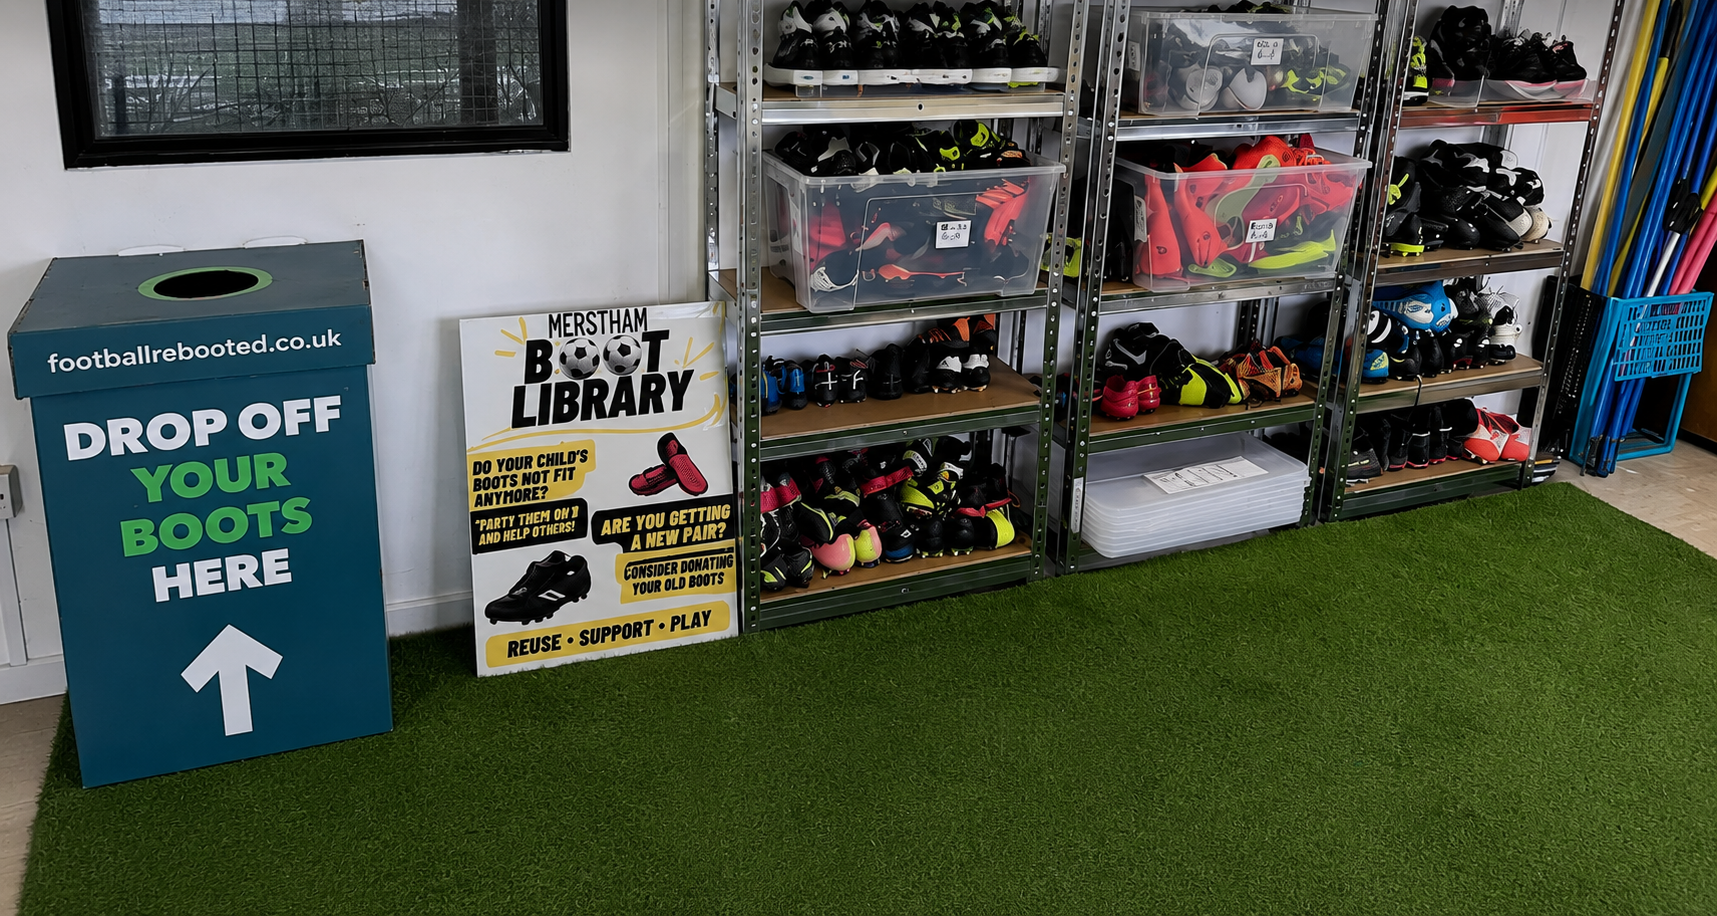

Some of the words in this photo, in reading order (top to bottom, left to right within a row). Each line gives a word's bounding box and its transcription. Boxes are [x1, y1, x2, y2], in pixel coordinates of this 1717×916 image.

[548, 307, 648, 339] MERSTHAM
[47, 329, 342, 373] footballrebooted.co.uk
[511, 369, 695, 429] LIBRARY
[63, 408, 228, 461] DROP
[238, 395, 341, 440] OFF
[130, 452, 292, 503] YOUR
[472, 460, 492, 476] DO
[496, 455, 533, 473] YOUR
[536, 449, 589, 468] CHILD'S
[473, 474, 518, 492] BOOTS
[521, 469, 550, 486] NOT
[553, 466, 576, 482] FIT
[474, 485, 549, 508] ANYMORE?
[120, 497, 313, 557] BOOTS
[478, 531, 501, 546] AND
[502, 526, 530, 542] HELP
[532, 520, 575, 538] OTHERS!
[518, 510, 550, 526] THEM
[600, 516, 632, 536] ARE
[636, 512, 665, 531] YOU
[669, 504, 731, 526] GETTING
[630, 534, 642, 551] A
[645, 529, 680, 549] NEW
[682, 522, 727, 543] PAIR?
[152, 548, 292, 602] HERE
[624, 561, 678, 581] CONSIDER
[632, 578, 662, 596] YOUR
[664, 576, 686, 592] OLD
[688, 571, 724, 589] BOOTS
[507, 633, 562, 658] REUSE
[579, 619, 655, 646] SUPPORT
[669, 610, 712, 632] PLAY
